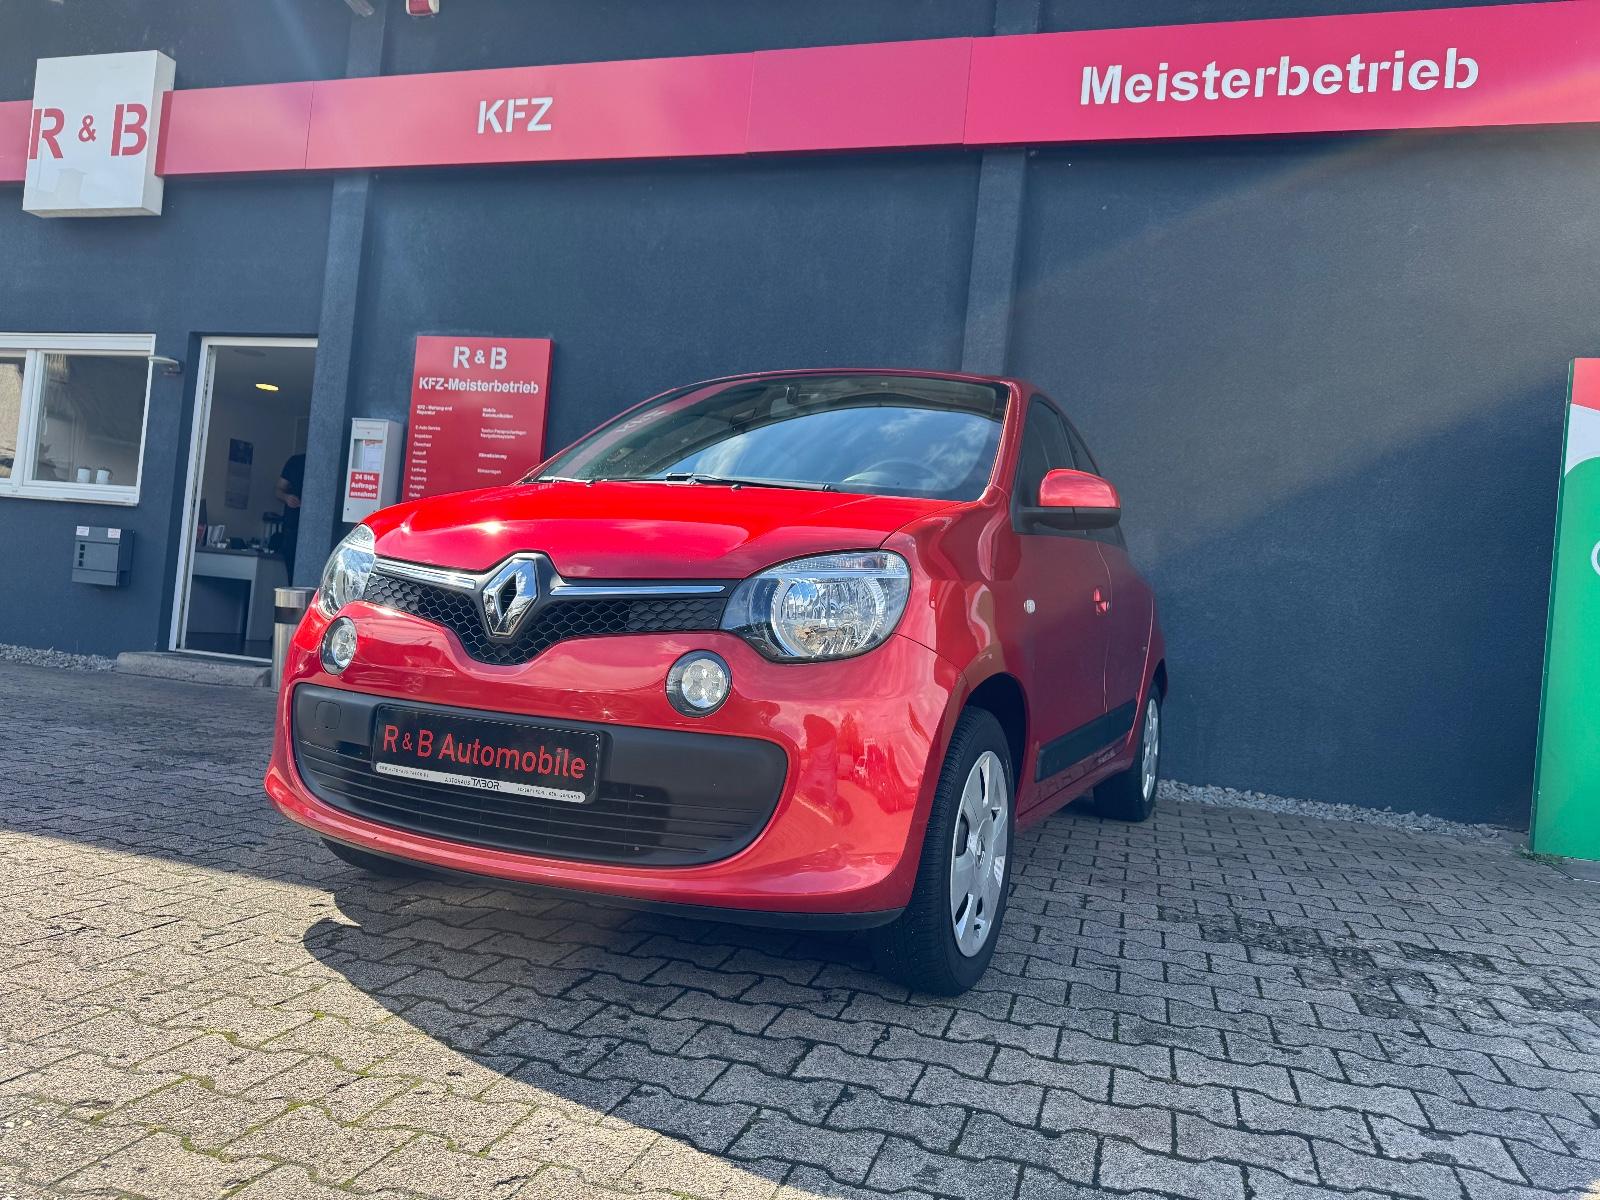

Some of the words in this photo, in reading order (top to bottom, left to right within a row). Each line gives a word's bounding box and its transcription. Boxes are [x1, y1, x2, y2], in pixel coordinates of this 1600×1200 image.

[1080, 47, 1480, 105] Meisterbetrieb
[477, 96, 554, 134] KFZ
[28, 107, 65, 160] R
[78, 114, 97, 143] &
[110, 103, 149, 157] B
[452, 345, 471, 369] R
[474, 349, 486, 365] &
[489, 346, 508, 370] B
[418, 376, 539, 394] KFZ-Meisterbetrieb
[350, 482, 378, 490] Auftrags-
[383, 724, 399, 753] R
[402, 731, 413, 751] &
[417, 729, 434, 758] B
[437, 733, 587, 779] Automobile
[471, 777, 501, 791] TABOR
